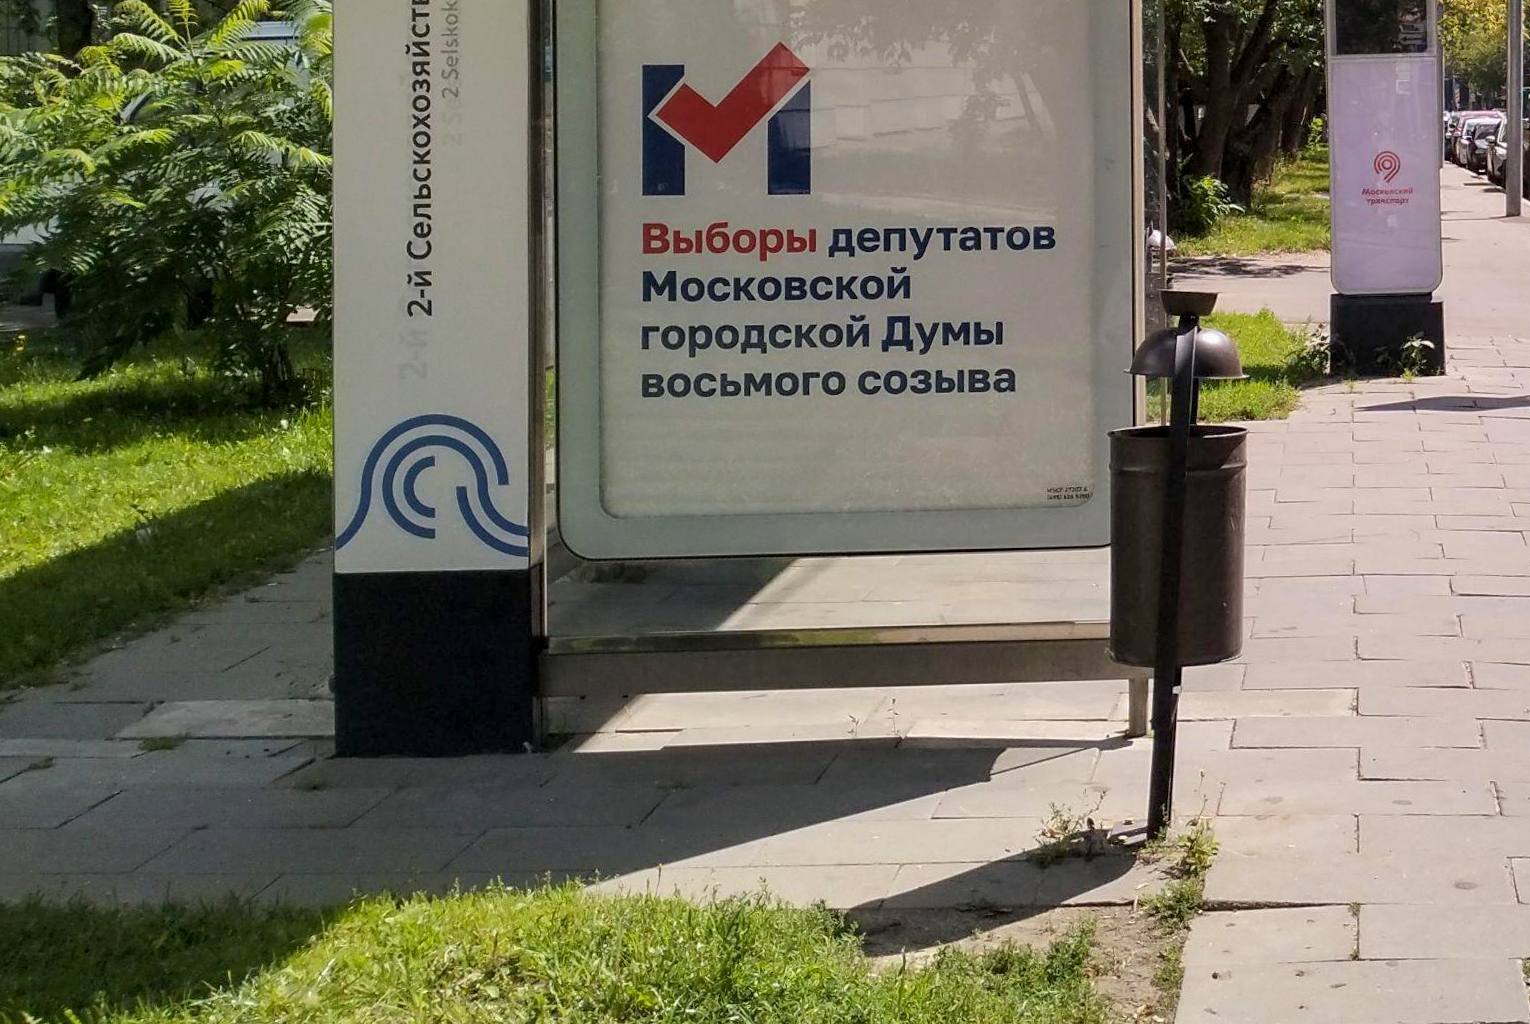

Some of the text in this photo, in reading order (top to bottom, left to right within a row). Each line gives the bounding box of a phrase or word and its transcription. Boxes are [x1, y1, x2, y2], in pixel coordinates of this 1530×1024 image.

[440, 86, 460, 99] 2
[641, 222, 1056, 261] Выборы депутатов
[406, 270, 433, 318] 2-й
[641, 266, 912, 302] Московской
[640, 314, 1004, 357] городской Думы
[641, 367, 1016, 398] восьмого созыва
